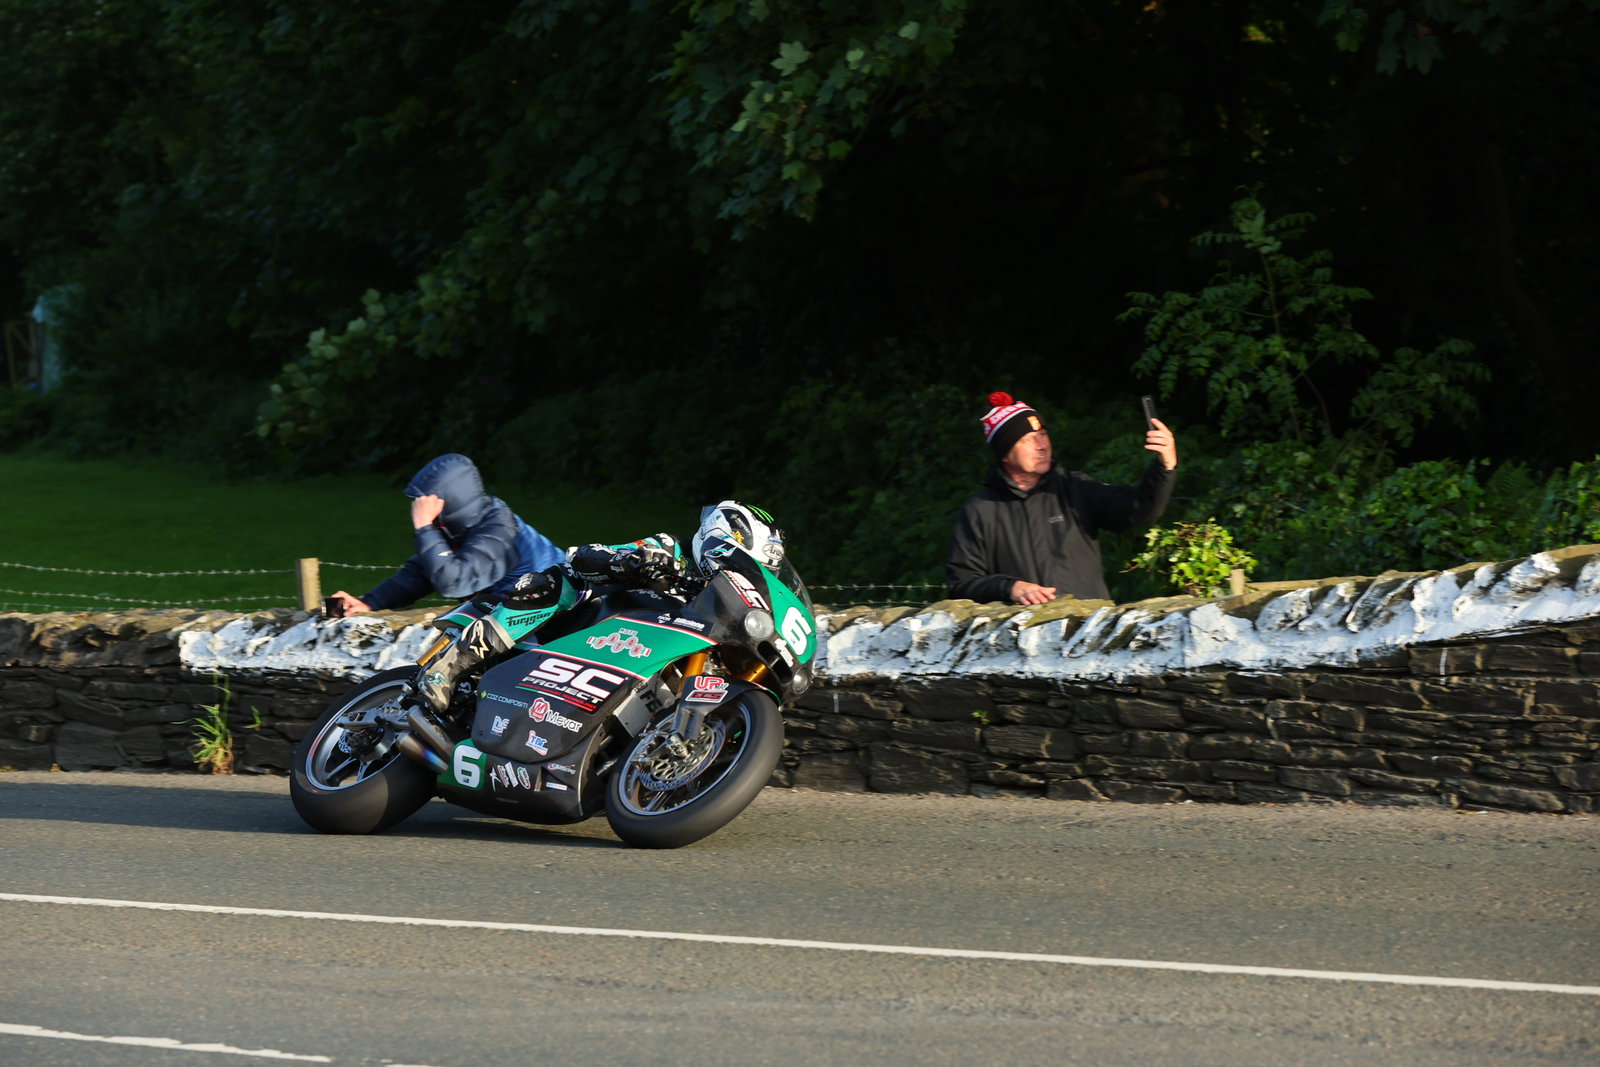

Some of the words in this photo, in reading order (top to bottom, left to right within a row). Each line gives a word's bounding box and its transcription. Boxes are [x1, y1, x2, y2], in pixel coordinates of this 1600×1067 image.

[506, 611, 553, 627] Furygan
[618, 627, 638, 637] MOTO
[781, 606, 812, 656] 6
[595, 634, 642, 655] PATON
[529, 657, 625, 699] SC
[694, 675, 725, 690] UP
[487, 692, 499, 701] CDZ
[521, 676, 604, 704] PROJECT
[545, 709, 583, 733] Mevar
[453, 744, 483, 788] 6
